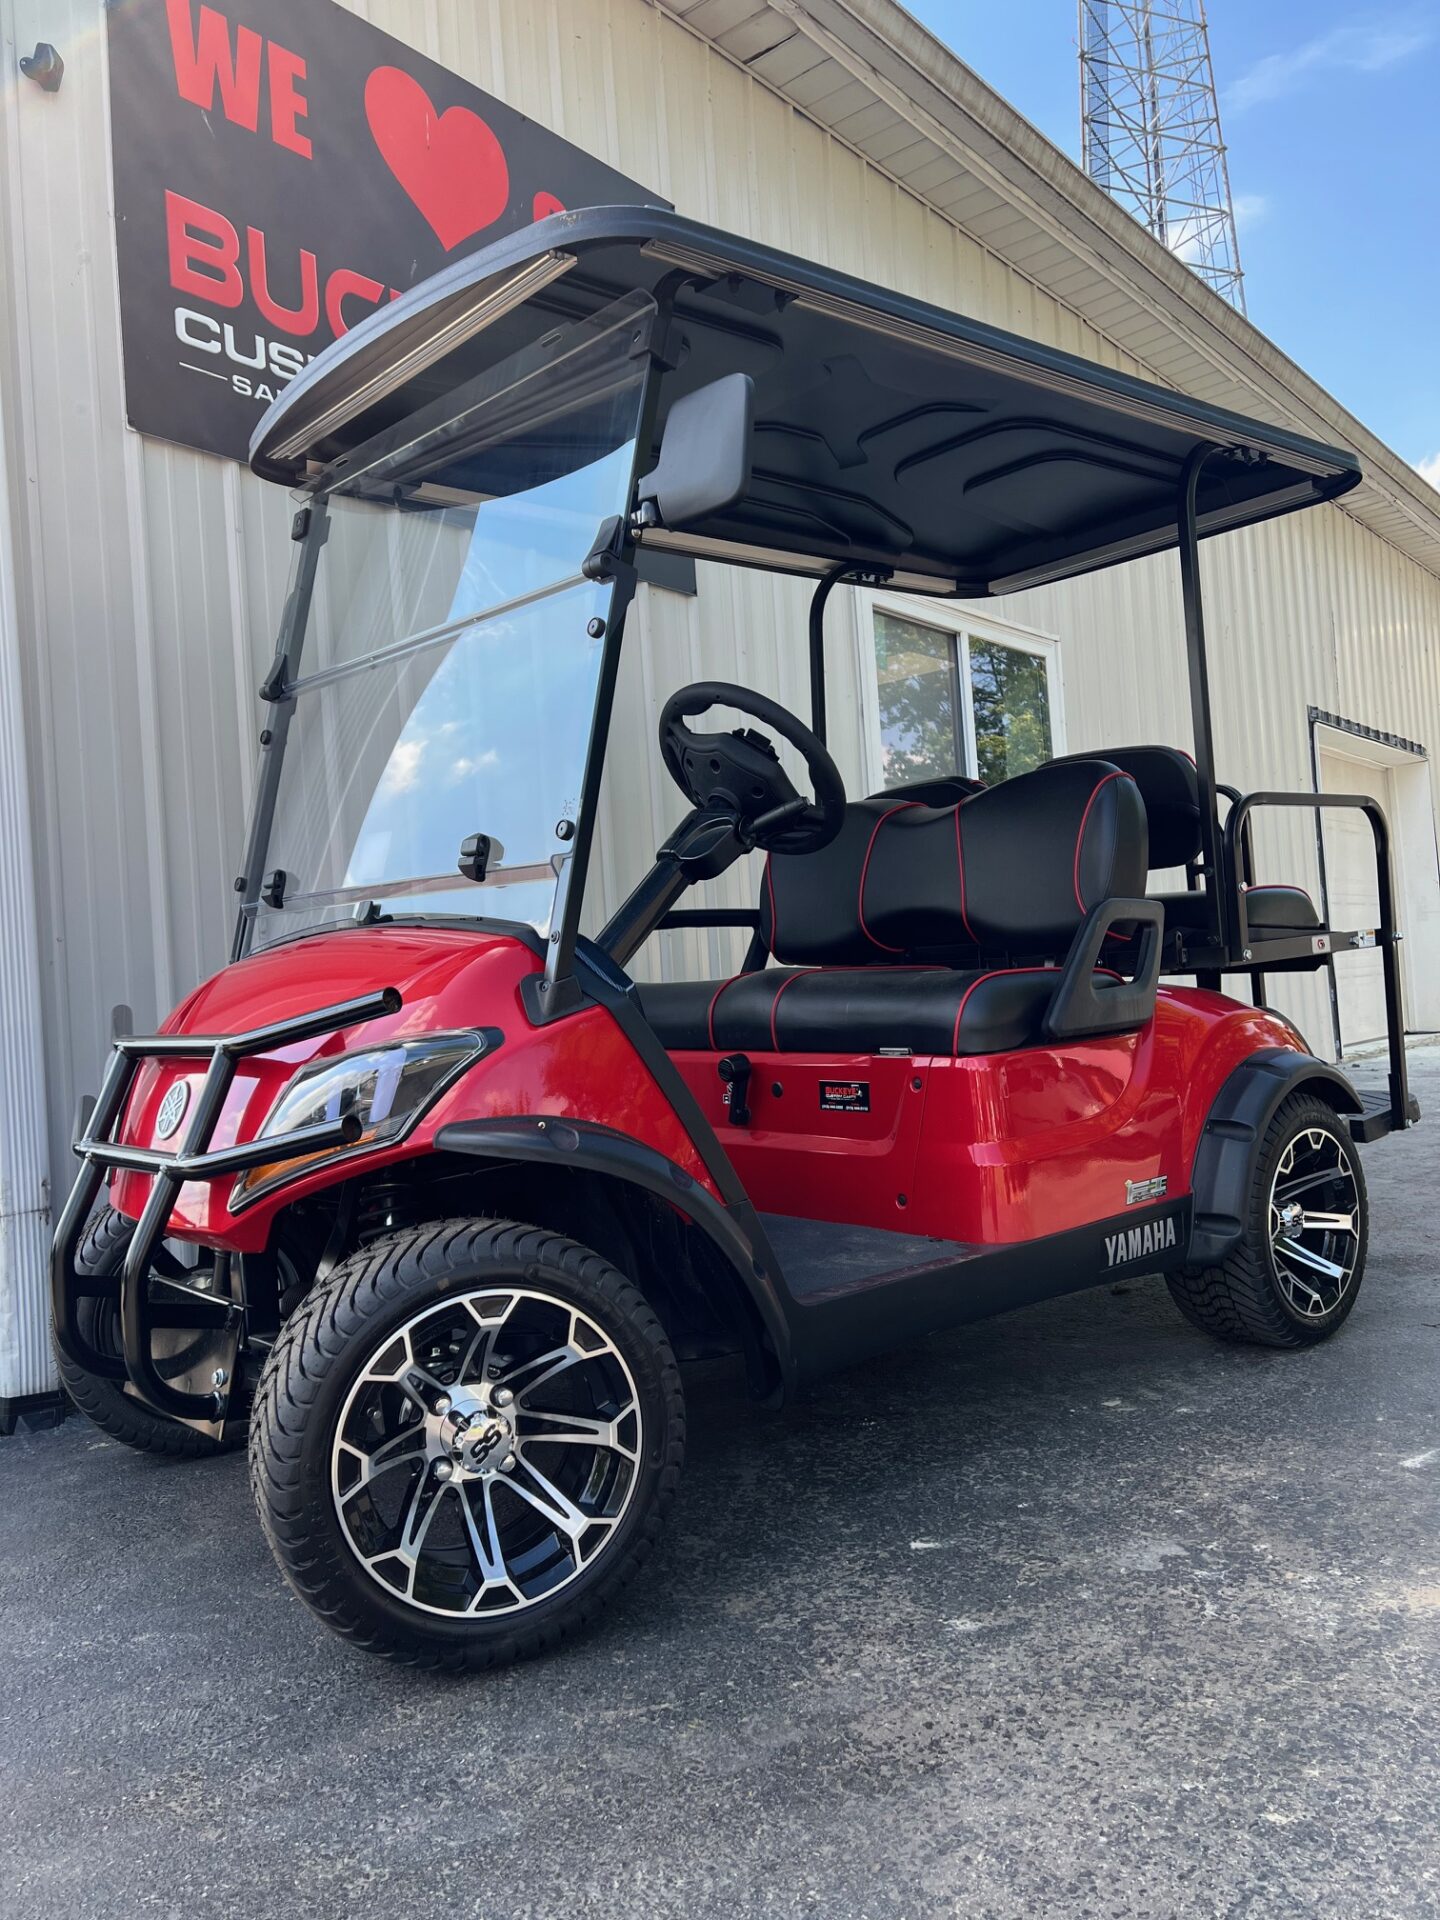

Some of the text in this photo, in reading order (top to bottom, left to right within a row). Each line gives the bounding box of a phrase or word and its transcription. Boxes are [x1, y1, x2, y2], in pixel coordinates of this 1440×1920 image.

[165, 0, 313, 160] WE
[165, 189, 404, 341] BUC
[174, 306, 317, 381] CUS
[232, 374, 283, 404] SA
[1104, 1217, 1176, 1267] YAMAHA
